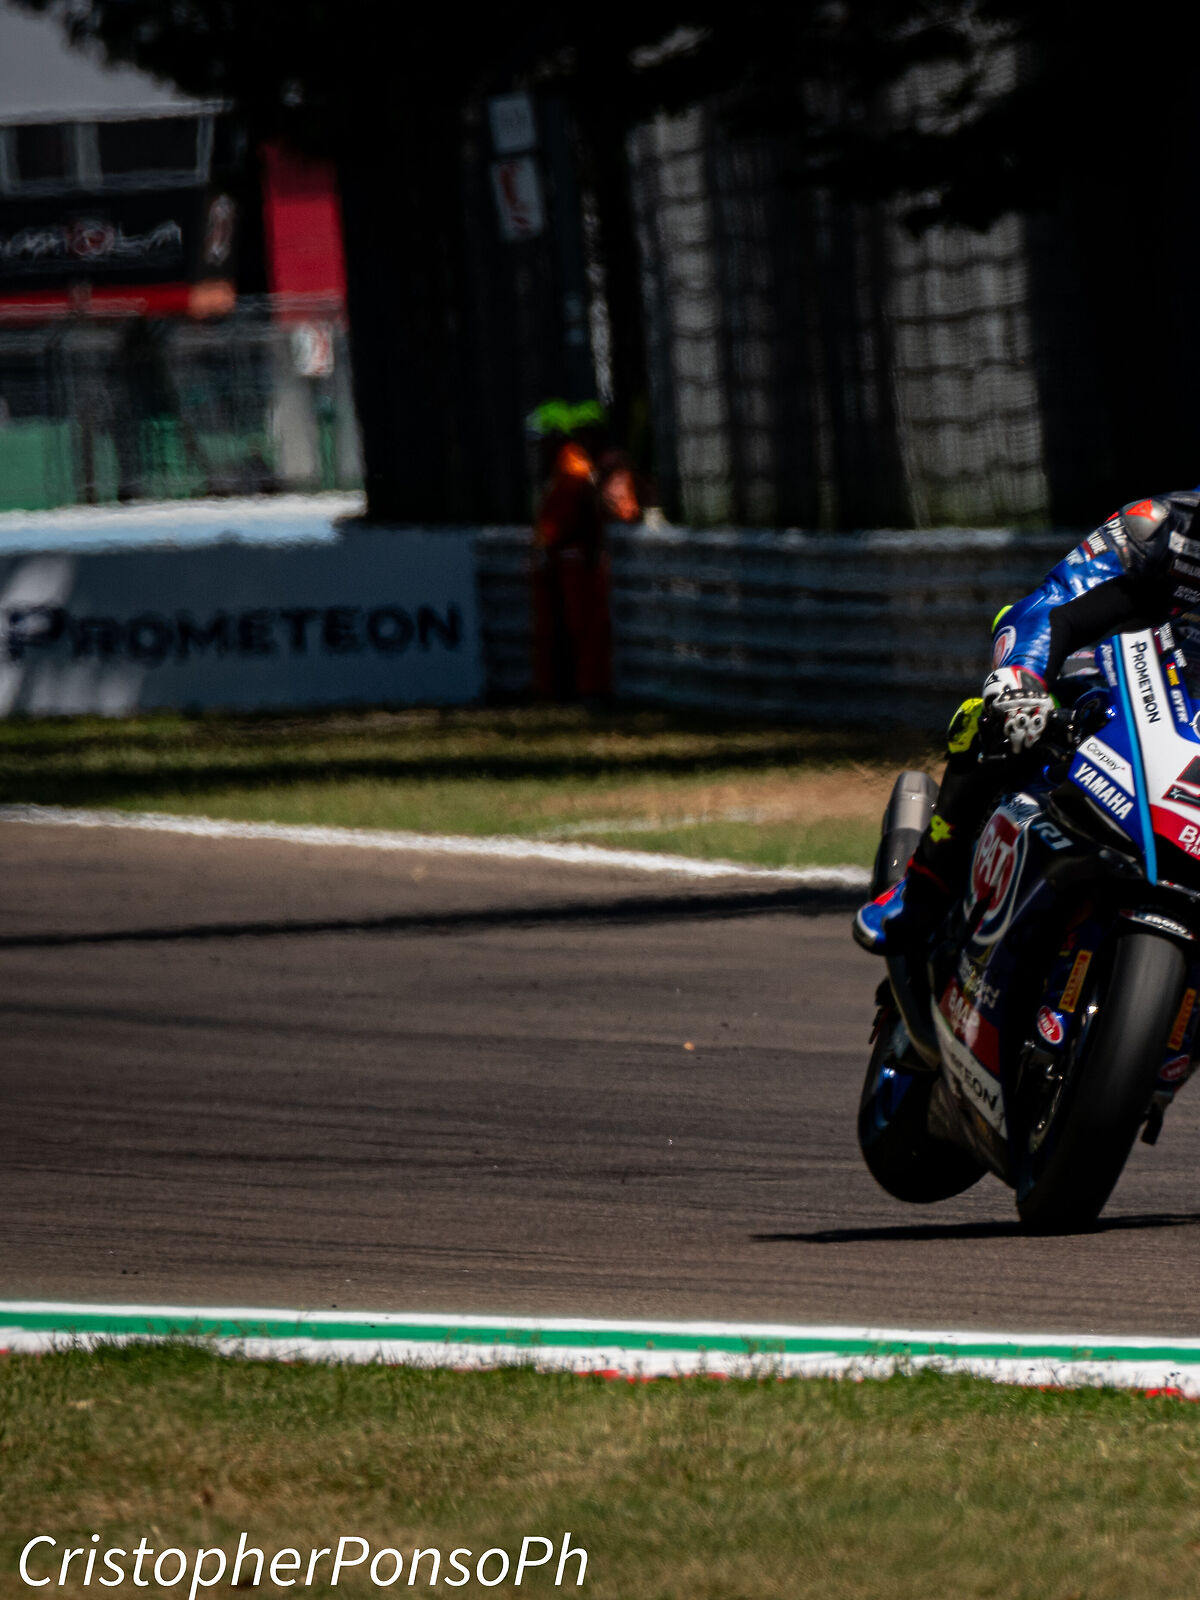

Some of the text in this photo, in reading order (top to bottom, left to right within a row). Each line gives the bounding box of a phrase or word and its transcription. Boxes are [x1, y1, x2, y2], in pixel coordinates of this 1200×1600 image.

[8, 603, 463, 667] PROMETEON
[1087, 742, 1120, 772] Corpay
[1074, 761, 1134, 820] YAMAHA
